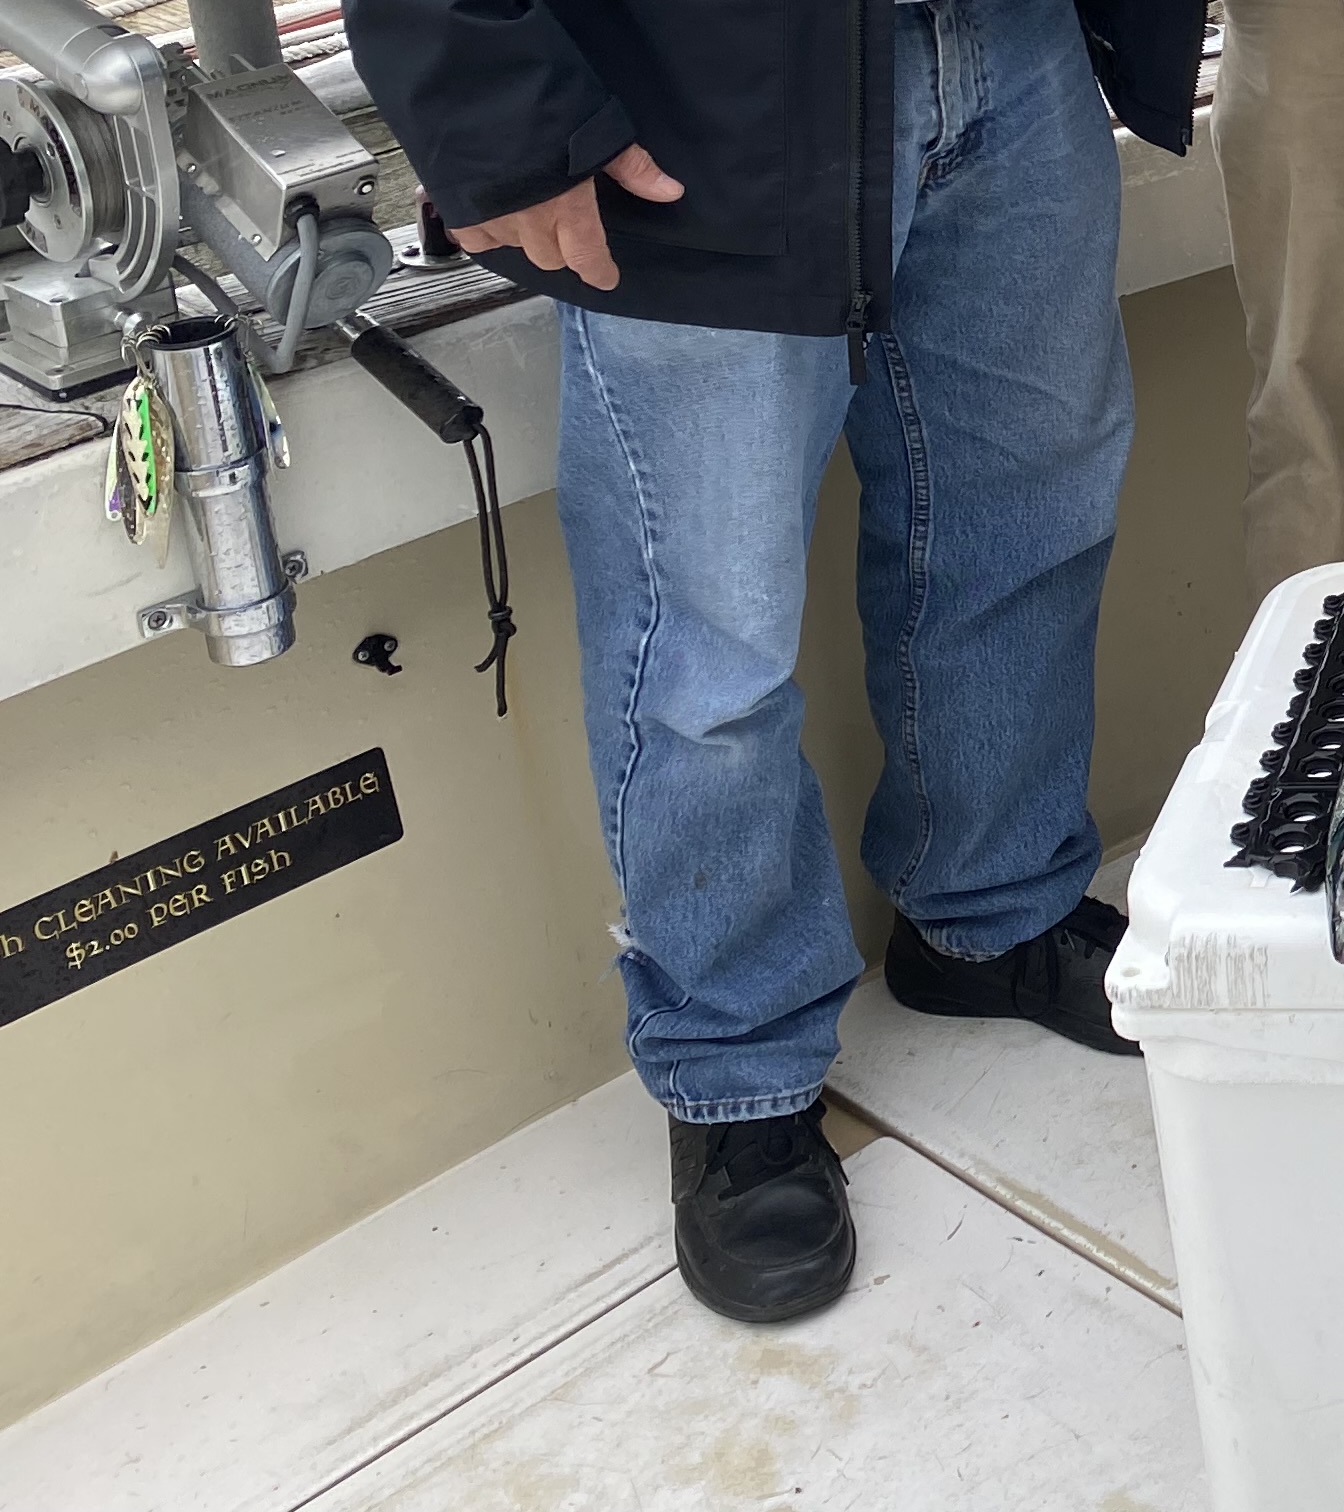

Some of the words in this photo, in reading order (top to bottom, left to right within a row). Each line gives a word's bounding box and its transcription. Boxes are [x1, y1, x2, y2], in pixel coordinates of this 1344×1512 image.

[33, 851, 206, 943] CLEANING
[213, 771, 380, 861] AVAILABLE
[65, 921, 139, 970] $2.00
[146, 884, 213, 928] PER
